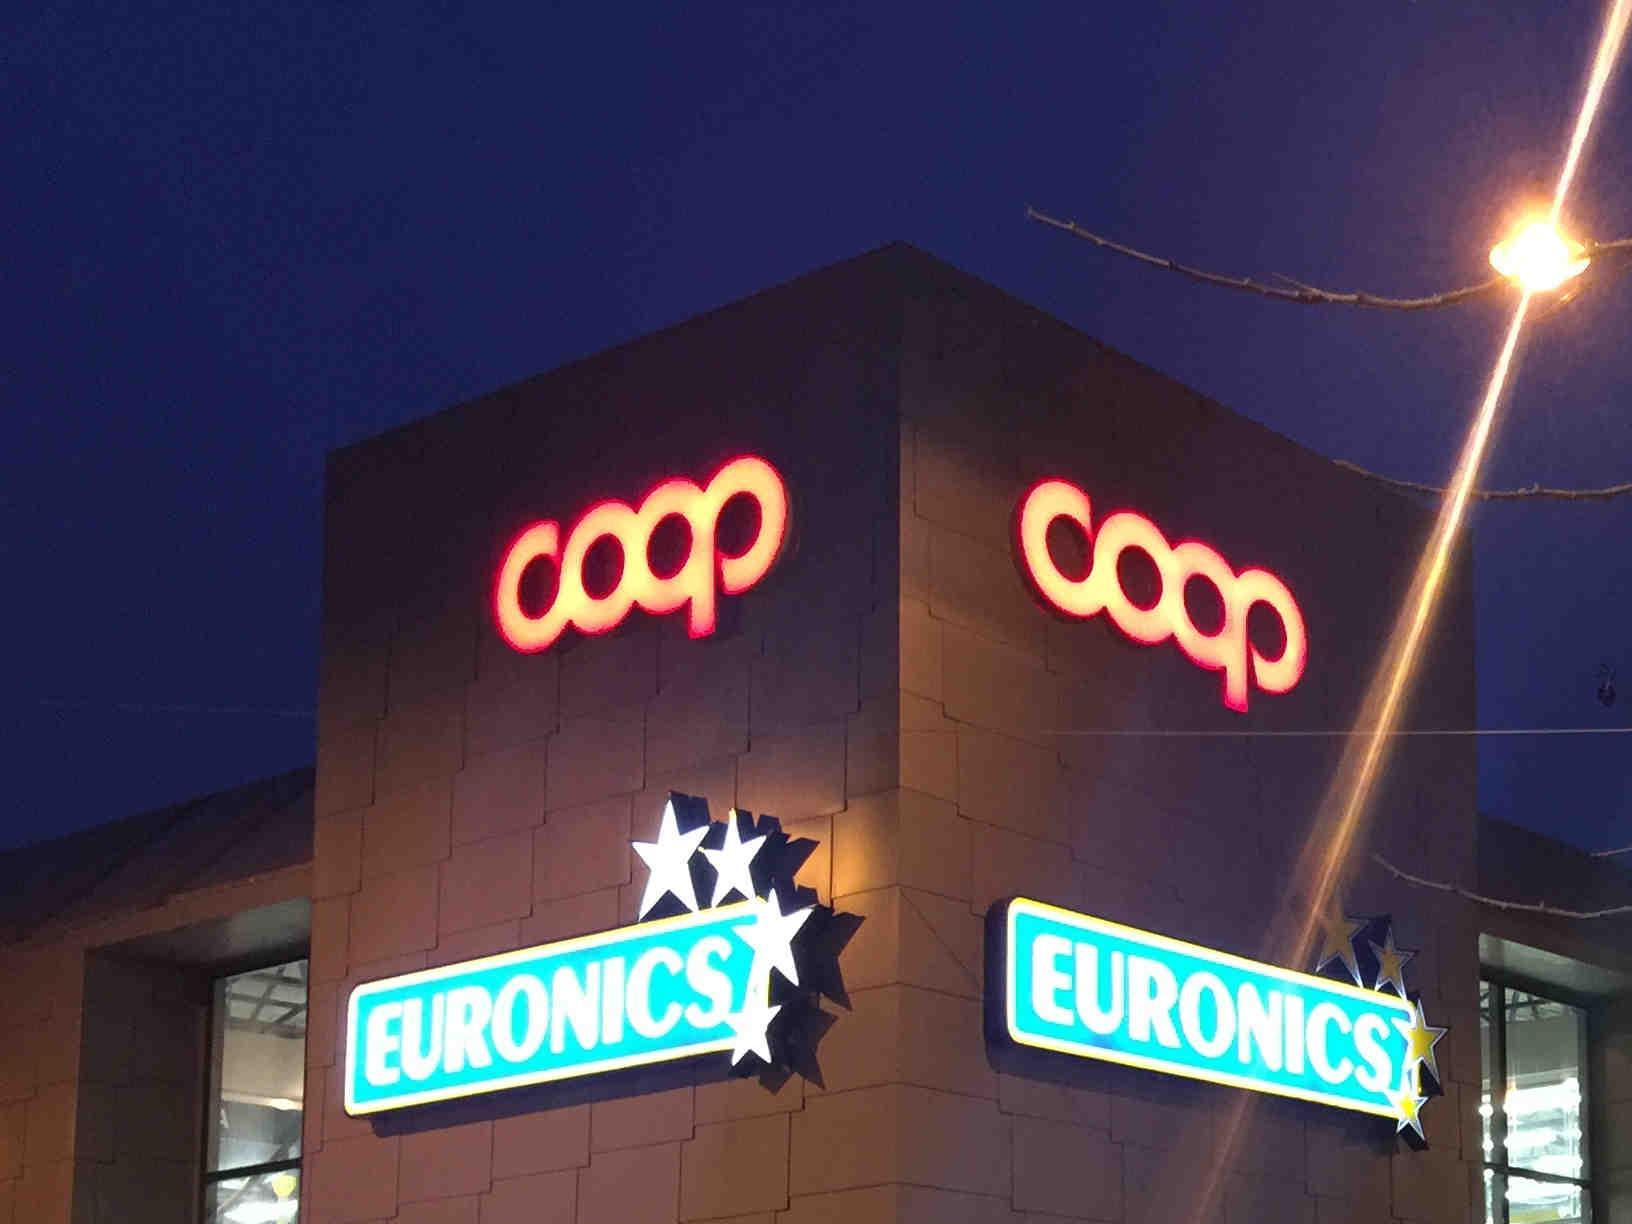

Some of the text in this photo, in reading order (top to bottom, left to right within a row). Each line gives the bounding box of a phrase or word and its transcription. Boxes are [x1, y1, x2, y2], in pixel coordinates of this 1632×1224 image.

[493, 454, 790, 655] coop
[1018, 477, 1309, 714] coop
[364, 935, 734, 1087] EURONICS
[1031, 933, 1391, 1093] EURONICS
